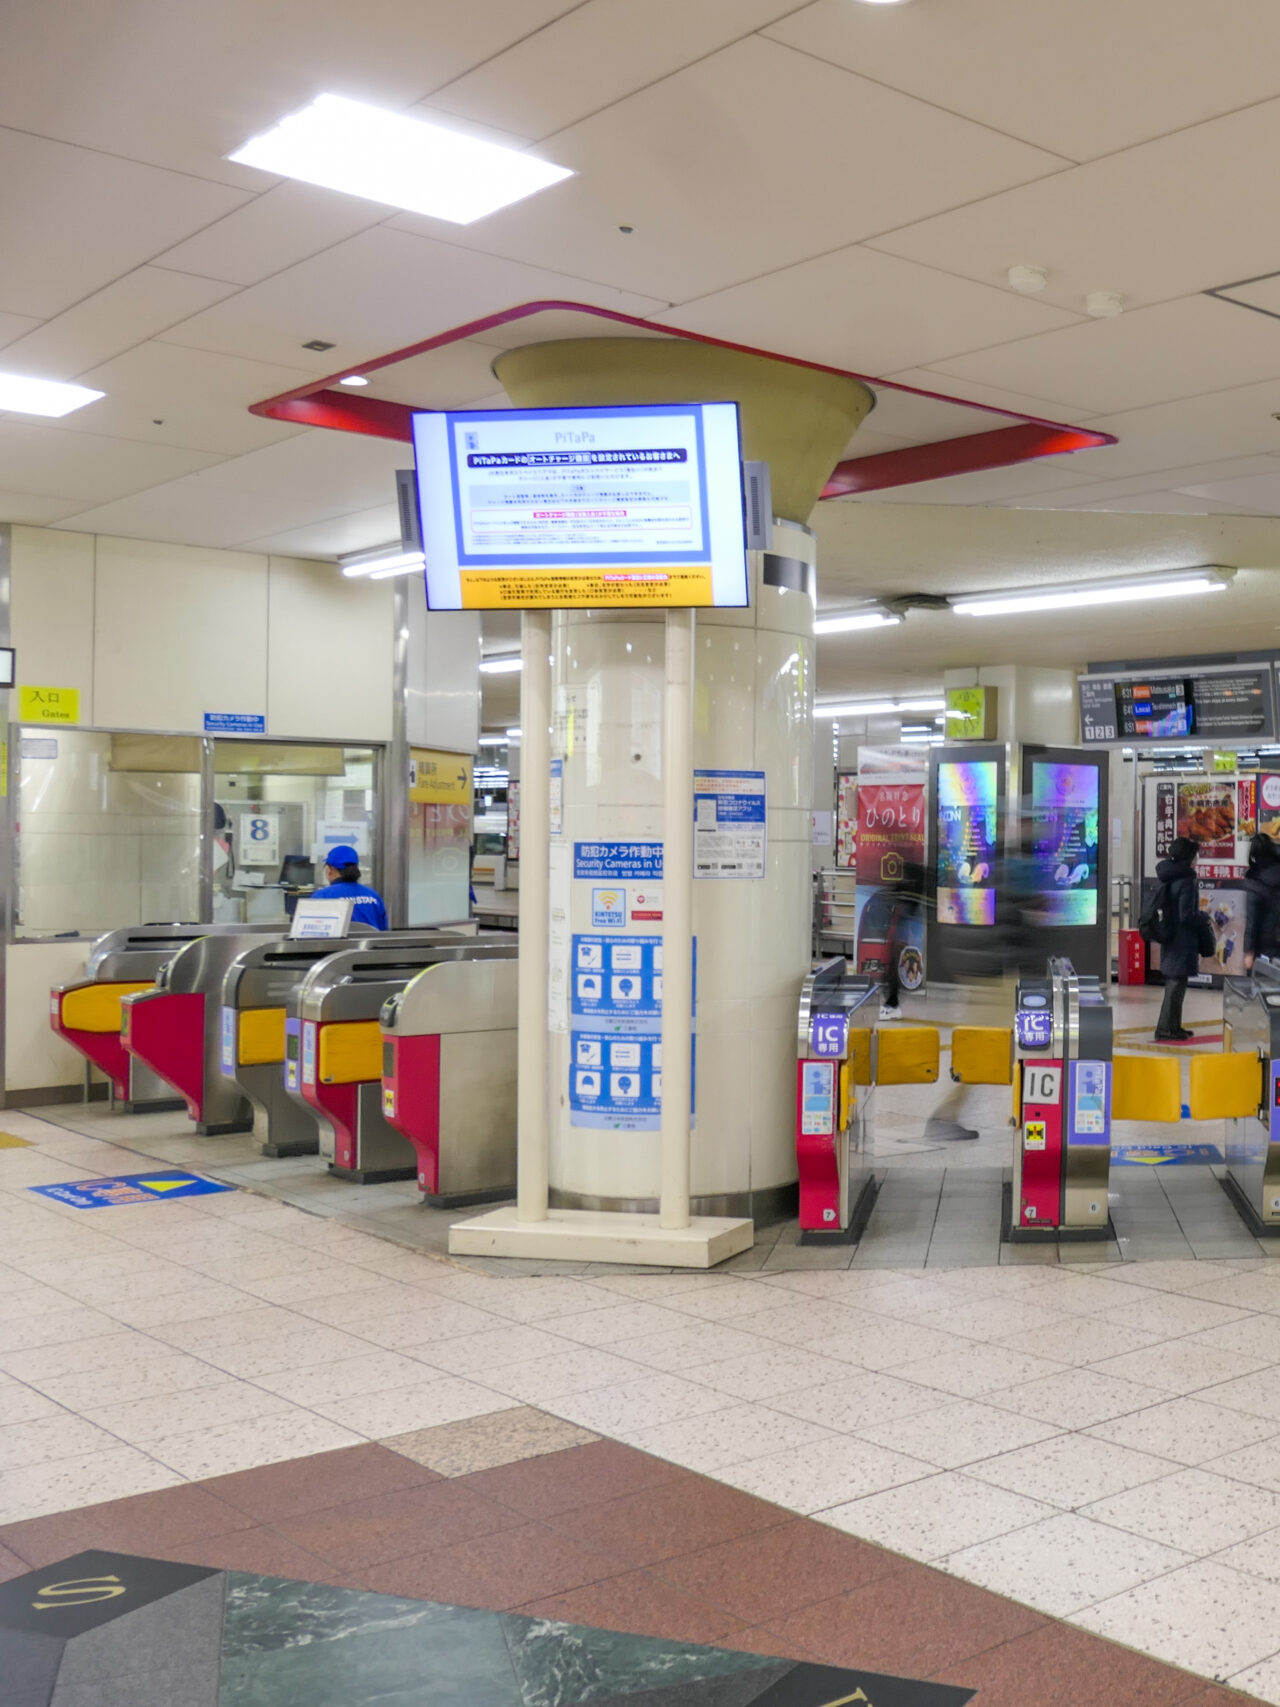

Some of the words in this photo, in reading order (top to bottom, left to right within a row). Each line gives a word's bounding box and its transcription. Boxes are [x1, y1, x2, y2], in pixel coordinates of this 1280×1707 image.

[555, 432, 596, 443] PiTaPa
[29, 690, 60, 703] 入口
[42, 709, 70, 718] Gates
[1135, 705, 1150, 714] Local
[866, 806, 921, 827] ひのとり
[250, 819, 269, 841] 8
[861, 834, 889, 842] ORIGINAL
[581, 845, 663, 858] 防犯カメラ作動中
[576, 858, 603, 870] Security
[604, 859, 642, 869] Cameras
[643, 859, 652, 869] in
[1024, 1015, 1044, 1031] IC
[818, 1026, 838, 1042] IC
[1025, 1031, 1045, 1042] 専用
[818, 1043, 838, 1053] 専用
[1030, 1072, 1054, 1098] IC
[32, 1575, 127, 1610] S
